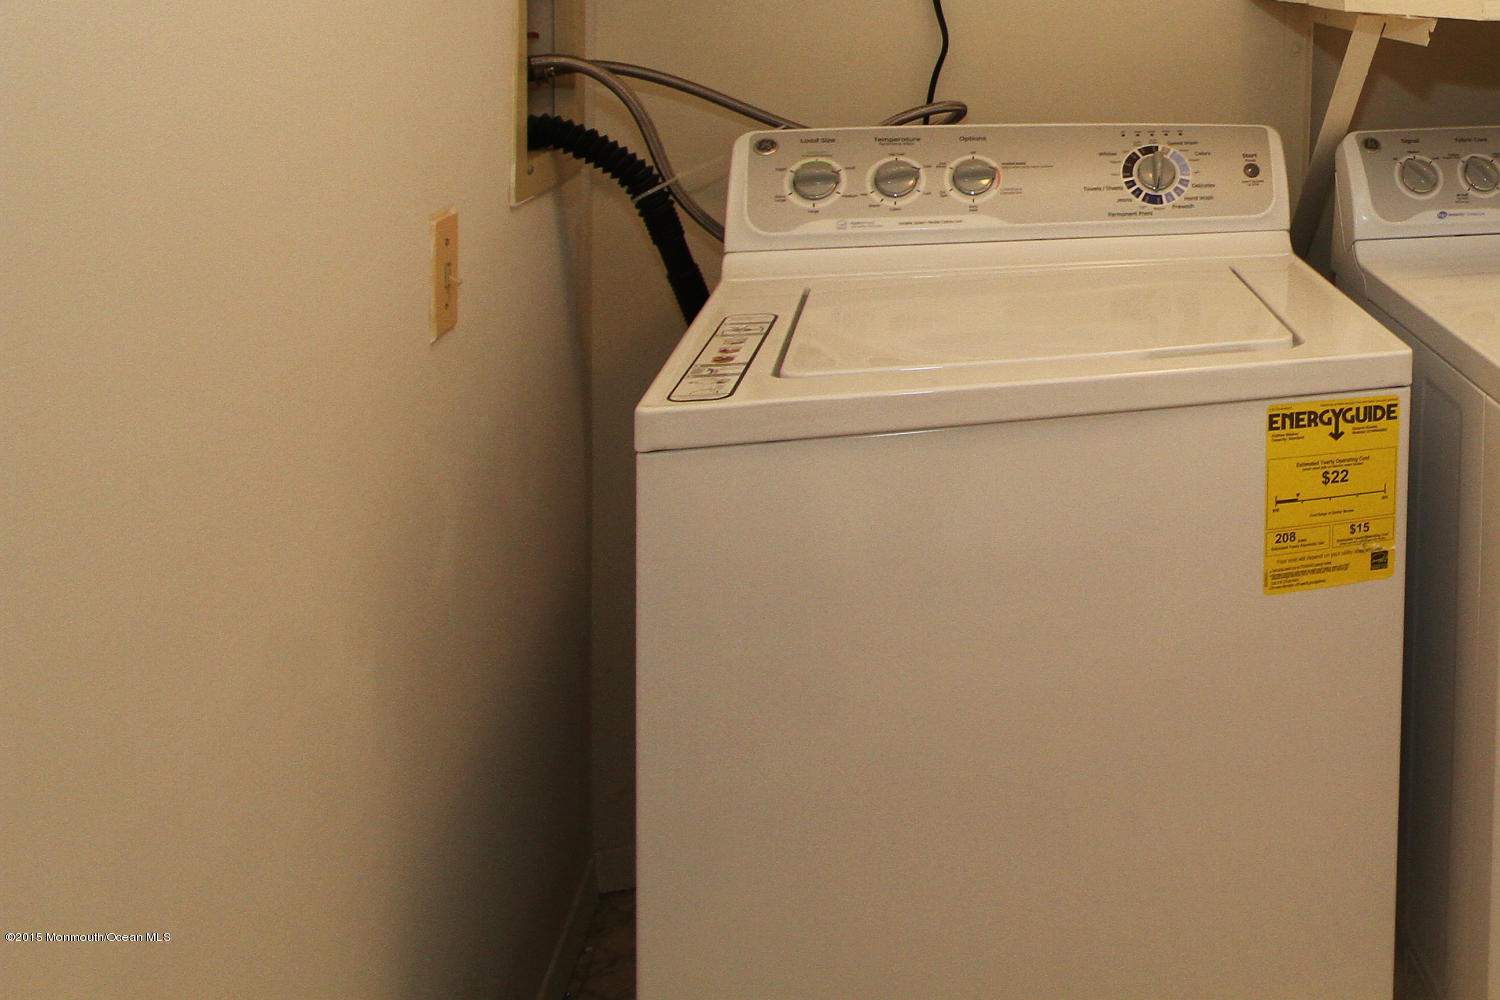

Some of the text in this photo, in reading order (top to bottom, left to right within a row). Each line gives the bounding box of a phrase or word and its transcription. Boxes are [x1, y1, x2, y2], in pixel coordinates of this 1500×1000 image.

[1268, 403, 1398, 432] ENERGYGUIDE
[1322, 469, 1349, 487] $22
[1350, 522, 1370, 535] $15
[1275, 531, 1296, 544] 208
